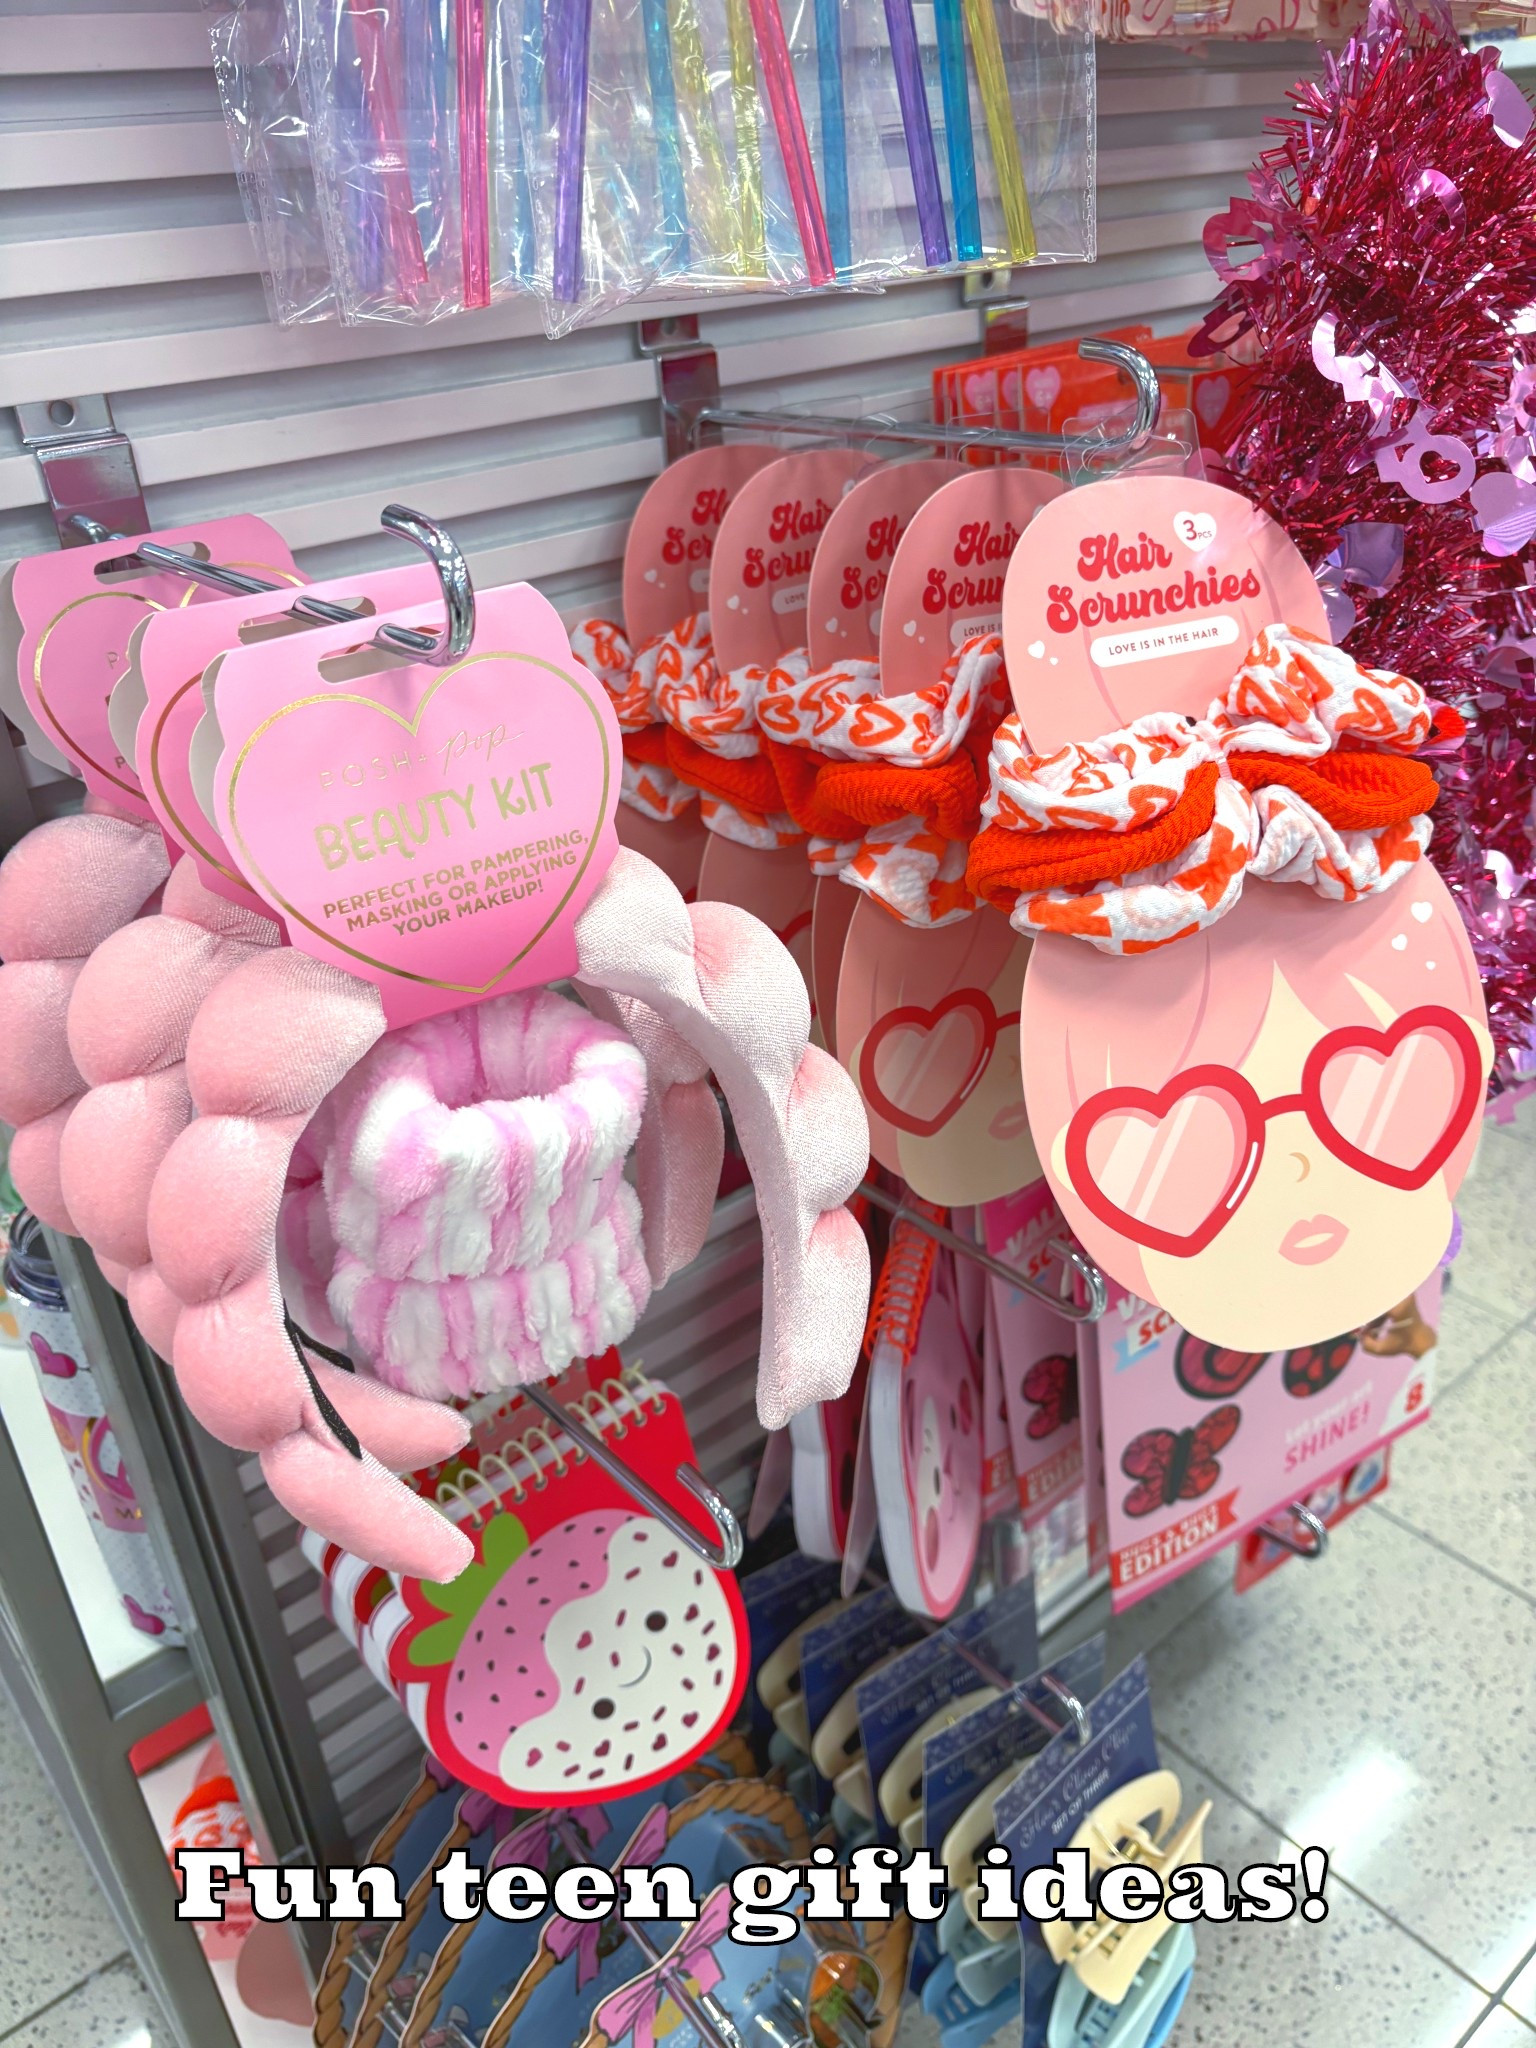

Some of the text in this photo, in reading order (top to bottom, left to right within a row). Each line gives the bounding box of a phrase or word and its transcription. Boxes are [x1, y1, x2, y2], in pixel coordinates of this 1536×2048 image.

[769, 498, 834, 543] Hair
[954, 521, 1021, 567] Hair
[1078, 532, 1173, 582] Hair
[1047, 566, 1261, 634] Scrunchies
[964, 625, 985, 637] LOVE
[987, 623, 996, 633] IS
[1108, 627, 1219, 656] LOVE IS IN THE HAIR
[319, 751, 412, 790] POSH
[314, 762, 553, 872] BEAUTY KIT
[322, 829, 590, 919] PERFECT FOR PAMPERING,
[346, 850, 578, 932] MASKING OR APPLYING
[392, 879, 545, 936] YOUR MAKEUP!
[1284, 1400, 1370, 1475] SHINE!
[1119, 1513, 1219, 1584] EDITION
